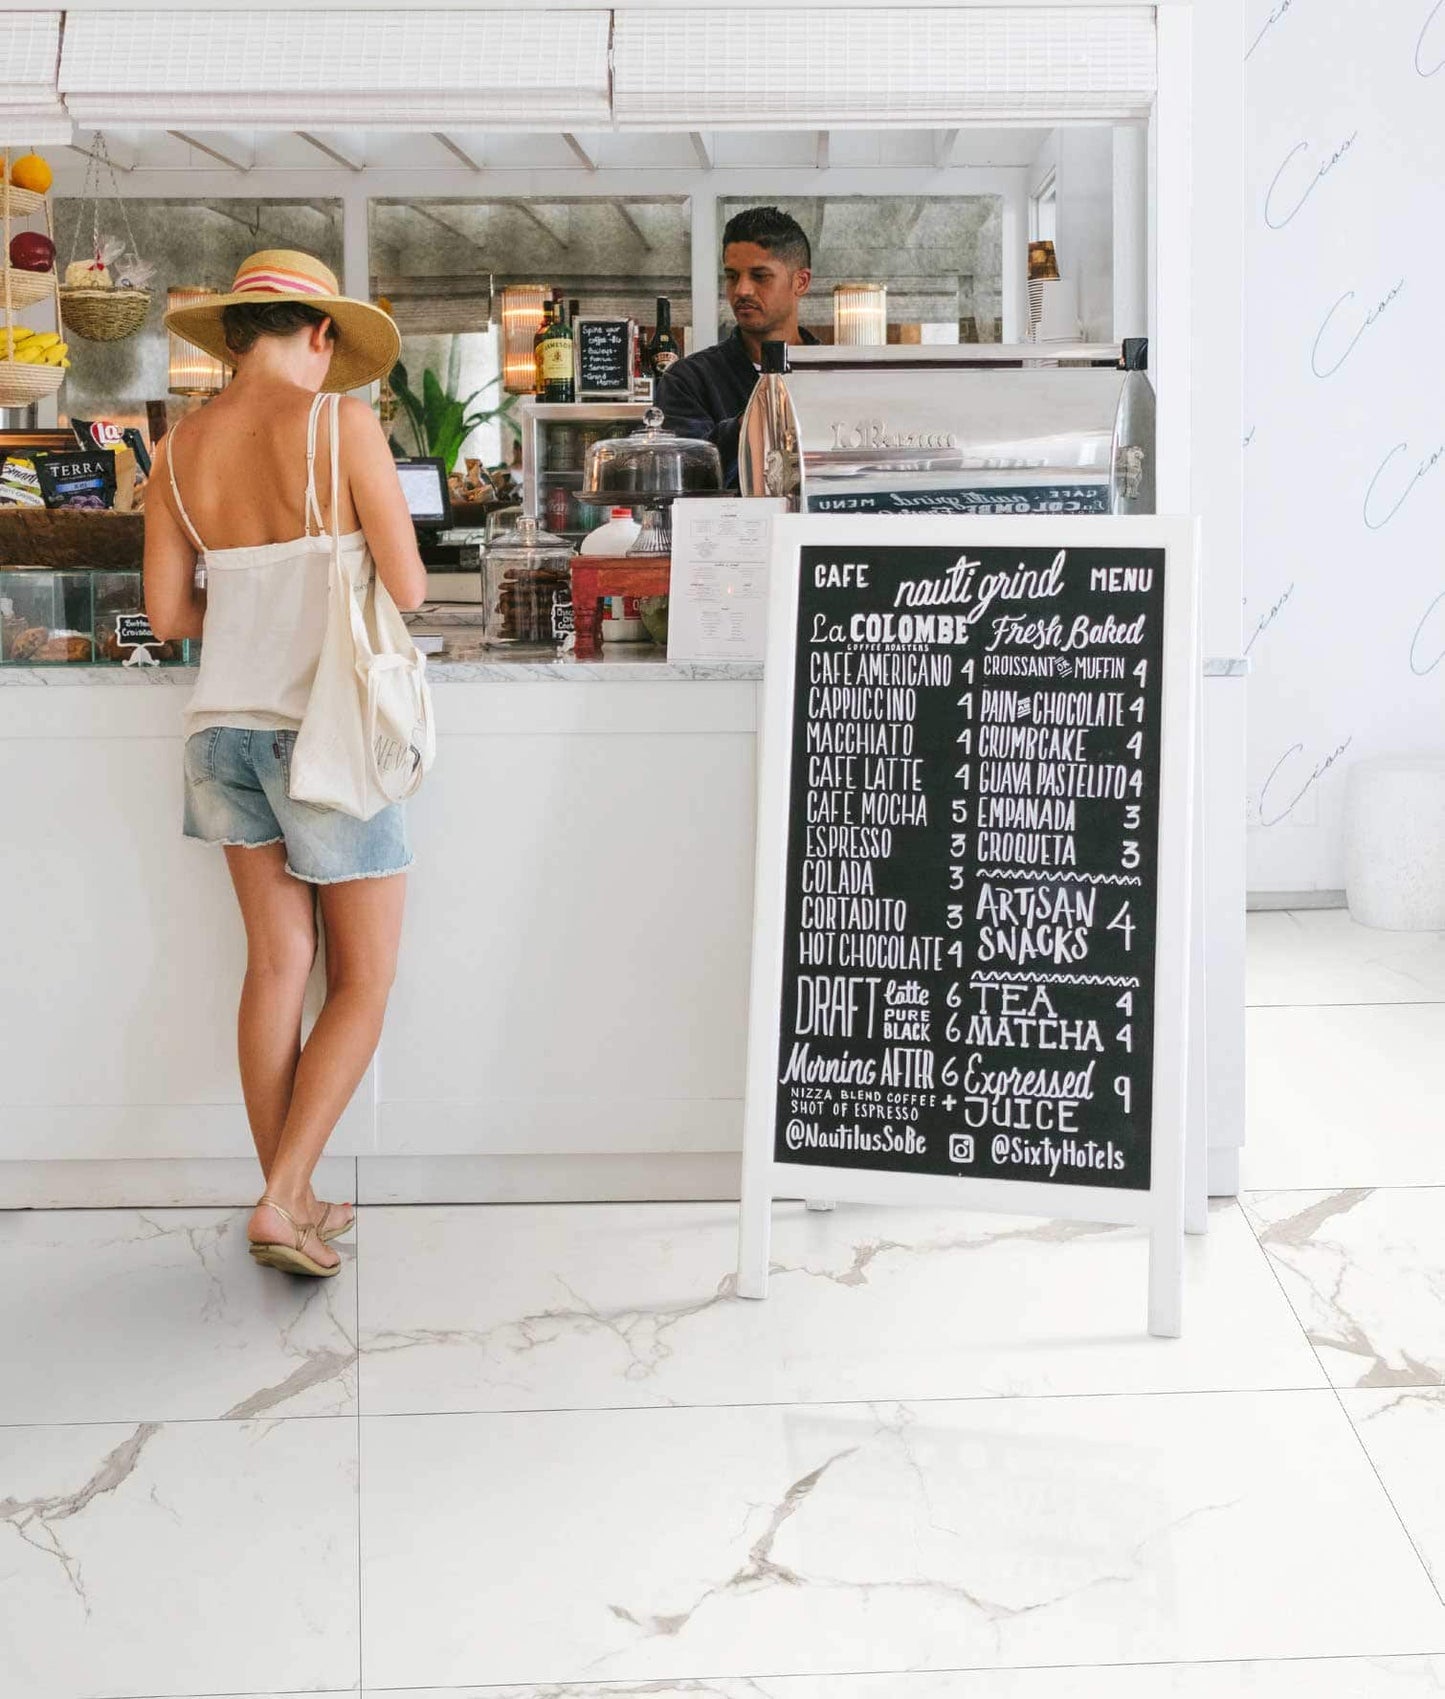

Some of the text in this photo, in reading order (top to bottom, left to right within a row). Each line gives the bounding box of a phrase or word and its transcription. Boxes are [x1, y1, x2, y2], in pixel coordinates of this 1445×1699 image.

[1265, 130, 1358, 229] Ciao
[1312, 275, 1404, 378] Ciao
[50, 462, 105, 477] TERRA
[1364, 442, 1445, 529] Cia
[814, 549, 1153, 624] CAFE nauti grind MENU
[809, 613, 970, 644] La COLOMBE
[985, 614, 1146, 651] Fresh Baked
[1244, 582, 1294, 655] iao
[847, 643, 930, 652] COFFEE ROASTERS
[809, 652, 975, 687] CAFE AMERICANO 4
[983, 656, 1055, 677] CROISSANT
[1074, 656, 1125, 679] MUFFIN
[1132, 659, 1148, 688] 4
[808, 687, 973, 722] CAPPUCCINO 4
[980, 689, 1018, 723] PAIN
[1032, 691, 1126, 727] CHOCOLATE
[1129, 696, 1145, 723] 4
[806, 722, 972, 756] MACCHIATO 4
[978, 725, 1144, 762] CRUMBCAKE 4
[808, 756, 971, 792] CAFE LATTE 4
[978, 761, 1143, 800] GUAVA PASTELITO 4
[1260, 735, 1352, 826] Ciao
[806, 791, 968, 827] CAFE MOCHA 5
[977, 797, 1142, 832] EMPANADA 3
[805, 825, 967, 859] ESPRESSO 3
[977, 831, 1141, 869] CROQUETA 3
[802, 860, 965, 896] COLADA 3
[800, 896, 964, 932] CORTADITO 3
[975, 883, 1096, 930] ARTISAN
[799, 931, 963, 972] HOT CHOCOLATE 4
[977, 900, 1136, 966] SNACKS 4
[794, 975, 962, 1039] DRAFT latte 6
[884, 1008, 931, 1023] PURE
[970, 981, 1133, 1019] TEA 4
[883, 1011, 961, 1043] BLACK 6
[965, 1015, 1132, 1054] MATCHA 4
[779, 1042, 959, 1090] Morning AFTER 6
[963, 1052, 1131, 1114] Expressed 9
[790, 1087, 833, 1100] NIZZA
[840, 1090, 882, 1103] BLEND
[886, 1092, 937, 1107] COFFEE
[791, 1101, 919, 1121] SHOT OF ESPRESSO
[964, 1095, 1080, 1133] JUICE
[785, 1118, 927, 1155] @NautilusSoBe
[990, 1133, 1126, 1178] @SixtyHotels
